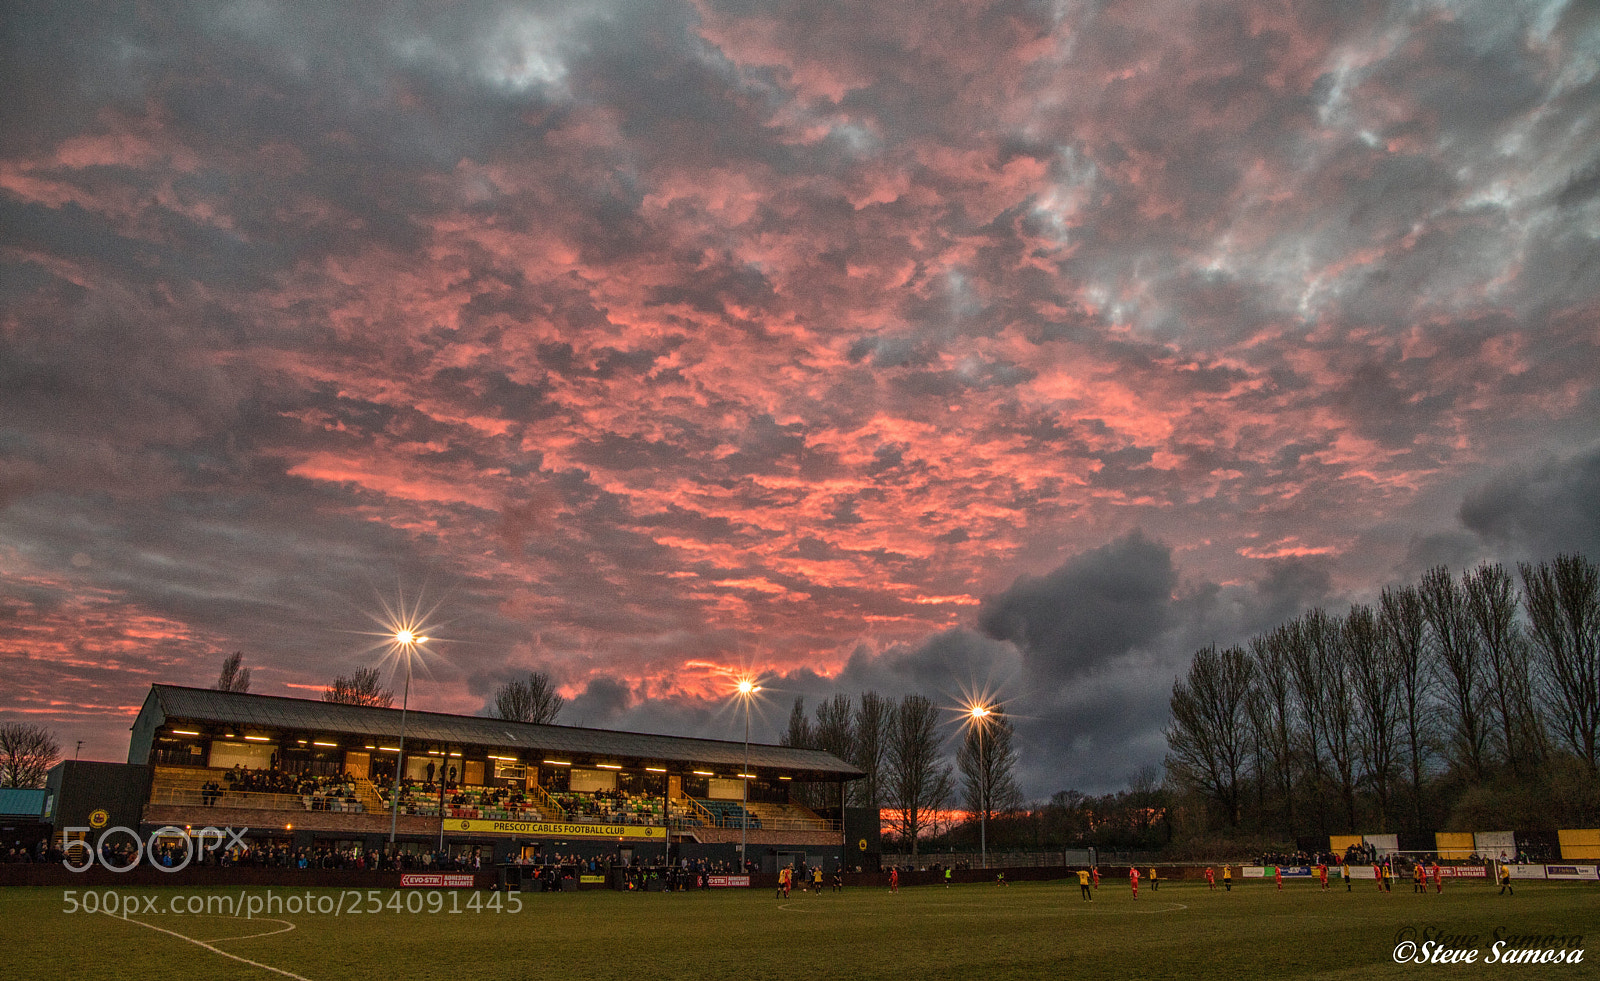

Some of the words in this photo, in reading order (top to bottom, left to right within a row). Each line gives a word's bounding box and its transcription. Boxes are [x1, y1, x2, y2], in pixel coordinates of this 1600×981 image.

[494, 822, 531, 832] PRESCOT
[532, 823, 563, 833] CABLES
[564, 824, 603, 834] FOOTBALL
[605, 826, 625, 835] CLUB
